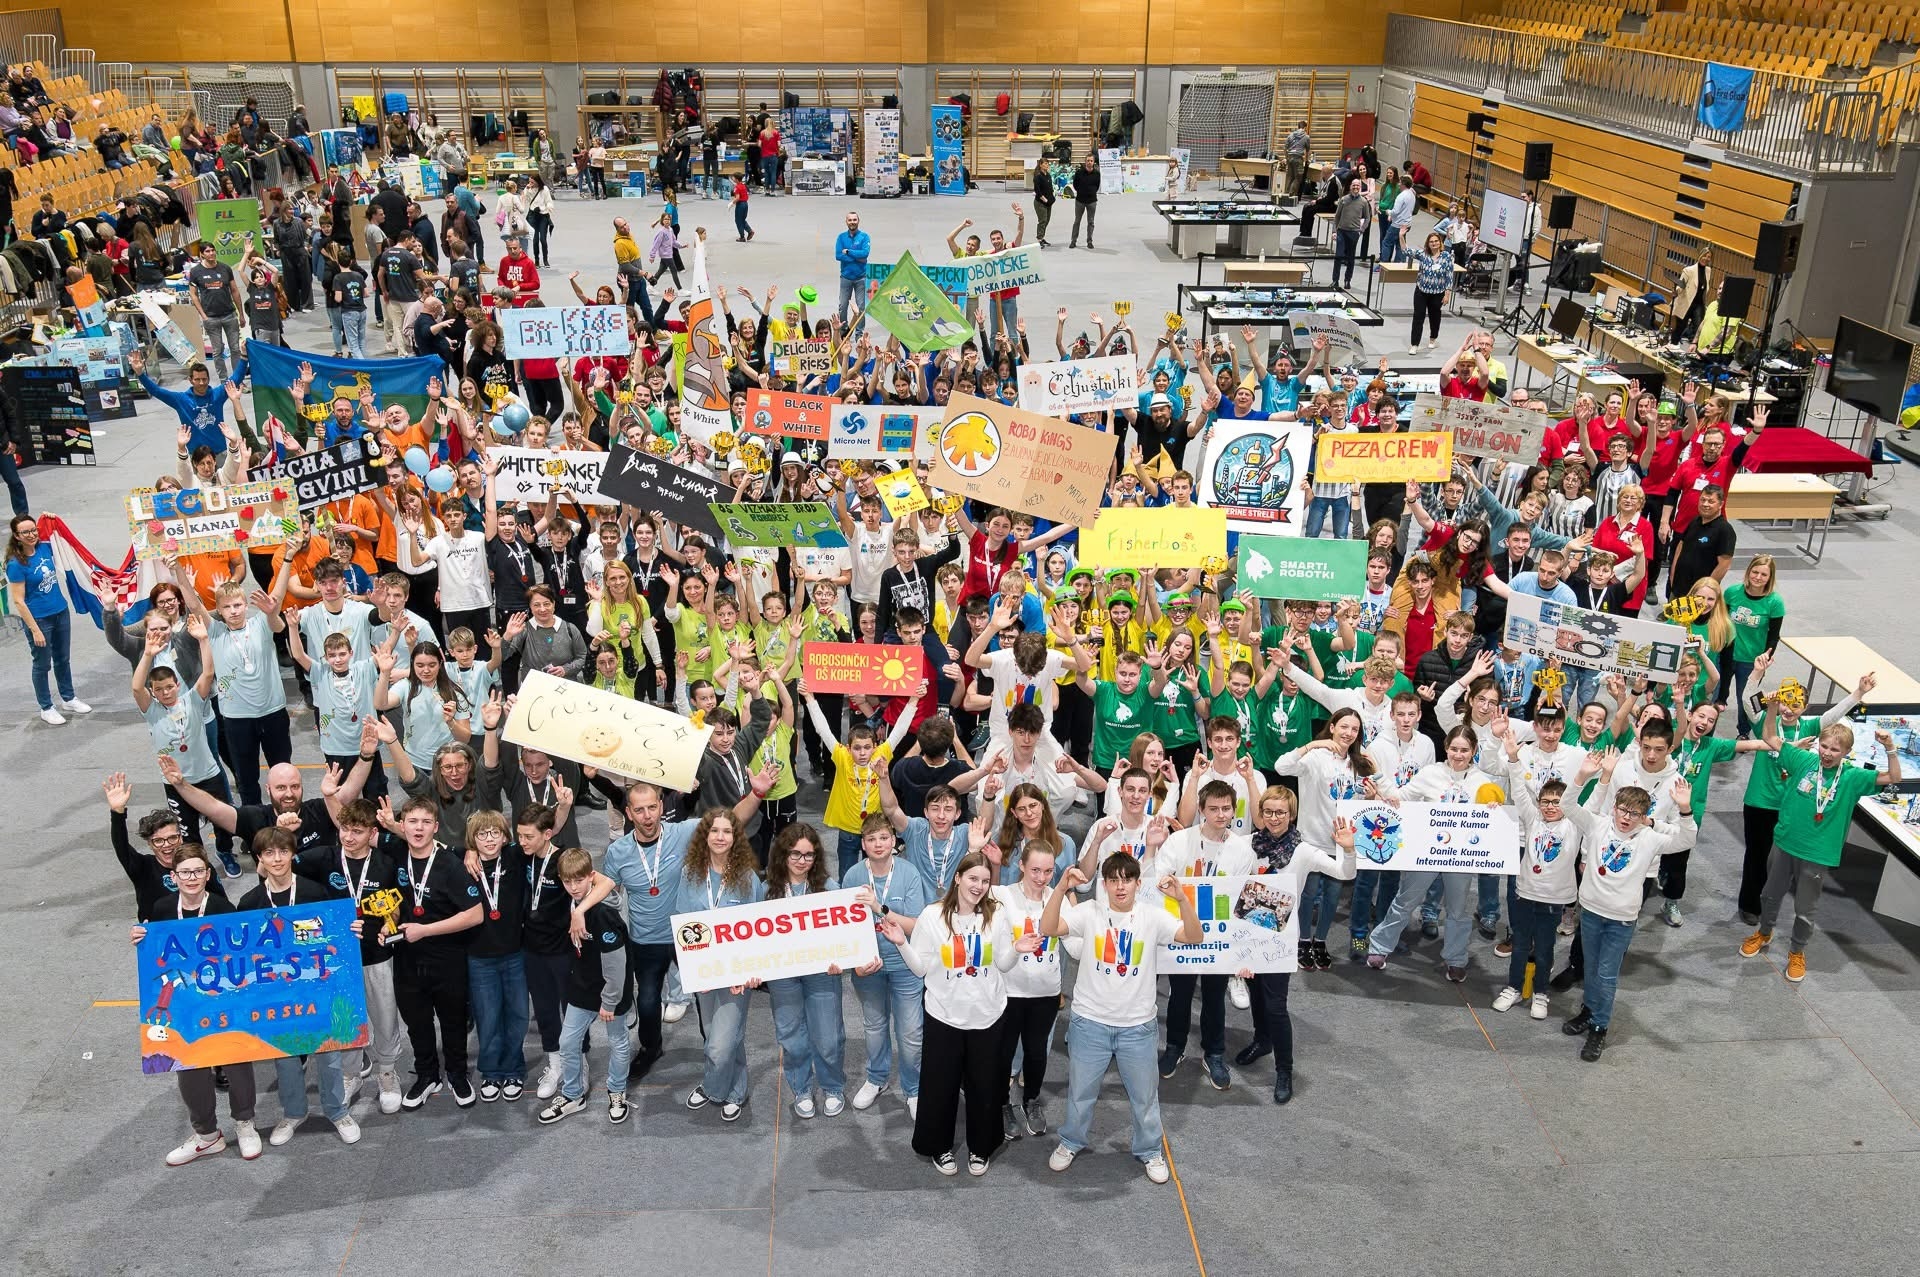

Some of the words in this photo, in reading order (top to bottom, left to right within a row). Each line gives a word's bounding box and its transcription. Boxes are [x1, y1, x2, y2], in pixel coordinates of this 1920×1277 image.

[215, 210, 235, 219] FLL
[507, 273, 515, 281] DO
[784, 399, 824, 411] BLACK
[683, 407, 690, 416] &
[693, 411, 720, 425] White
[799, 412, 807, 421] &
[783, 422, 822, 434] WHITE
[1008, 420, 1036, 441] ROBO
[834, 437, 855, 445] Micro
[857, 437, 871, 445] Net
[1490, 432, 1522, 454] NO
[1332, 440, 1380, 458] PIZZA
[1384, 440, 1439, 458] CREW
[620, 451, 659, 478] BLACK
[516, 481, 533, 493] OŠ
[130, 488, 228, 520] LEGO
[231, 493, 270, 506] škrati
[1248, 510, 1274, 518] STRELE
[190, 519, 239, 534] KANAL
[1280, 560, 1328, 571] SMARTI
[1280, 569, 1335, 579] ROBOTKI
[1528, 648, 1545, 659] OŠ
[808, 652, 870, 668] ROBOSONČKI
[815, 667, 828, 680] OŠ
[830, 669, 862, 682] KOPER
[1352, 806, 1386, 821] DOMINANT
[1429, 808, 1468, 818] Osnovna
[1471, 808, 1490, 819] šola
[1429, 819, 1457, 828] Danile
[1460, 820, 1490, 829] Kumar
[1429, 847, 1458, 856] Danile
[1460, 848, 1491, 857] Kumar
[1416, 857, 1474, 867] International
[1475, 859, 1505, 869] school
[714, 903, 867, 944] ROOSTERS
[161, 918, 282, 962] AQUA
[1176, 955, 1216, 964] Ormož
[195, 949, 334, 993] QUEST
[200, 1013, 228, 1028] OŠ
[251, 1003, 317, 1022] DRSKA
